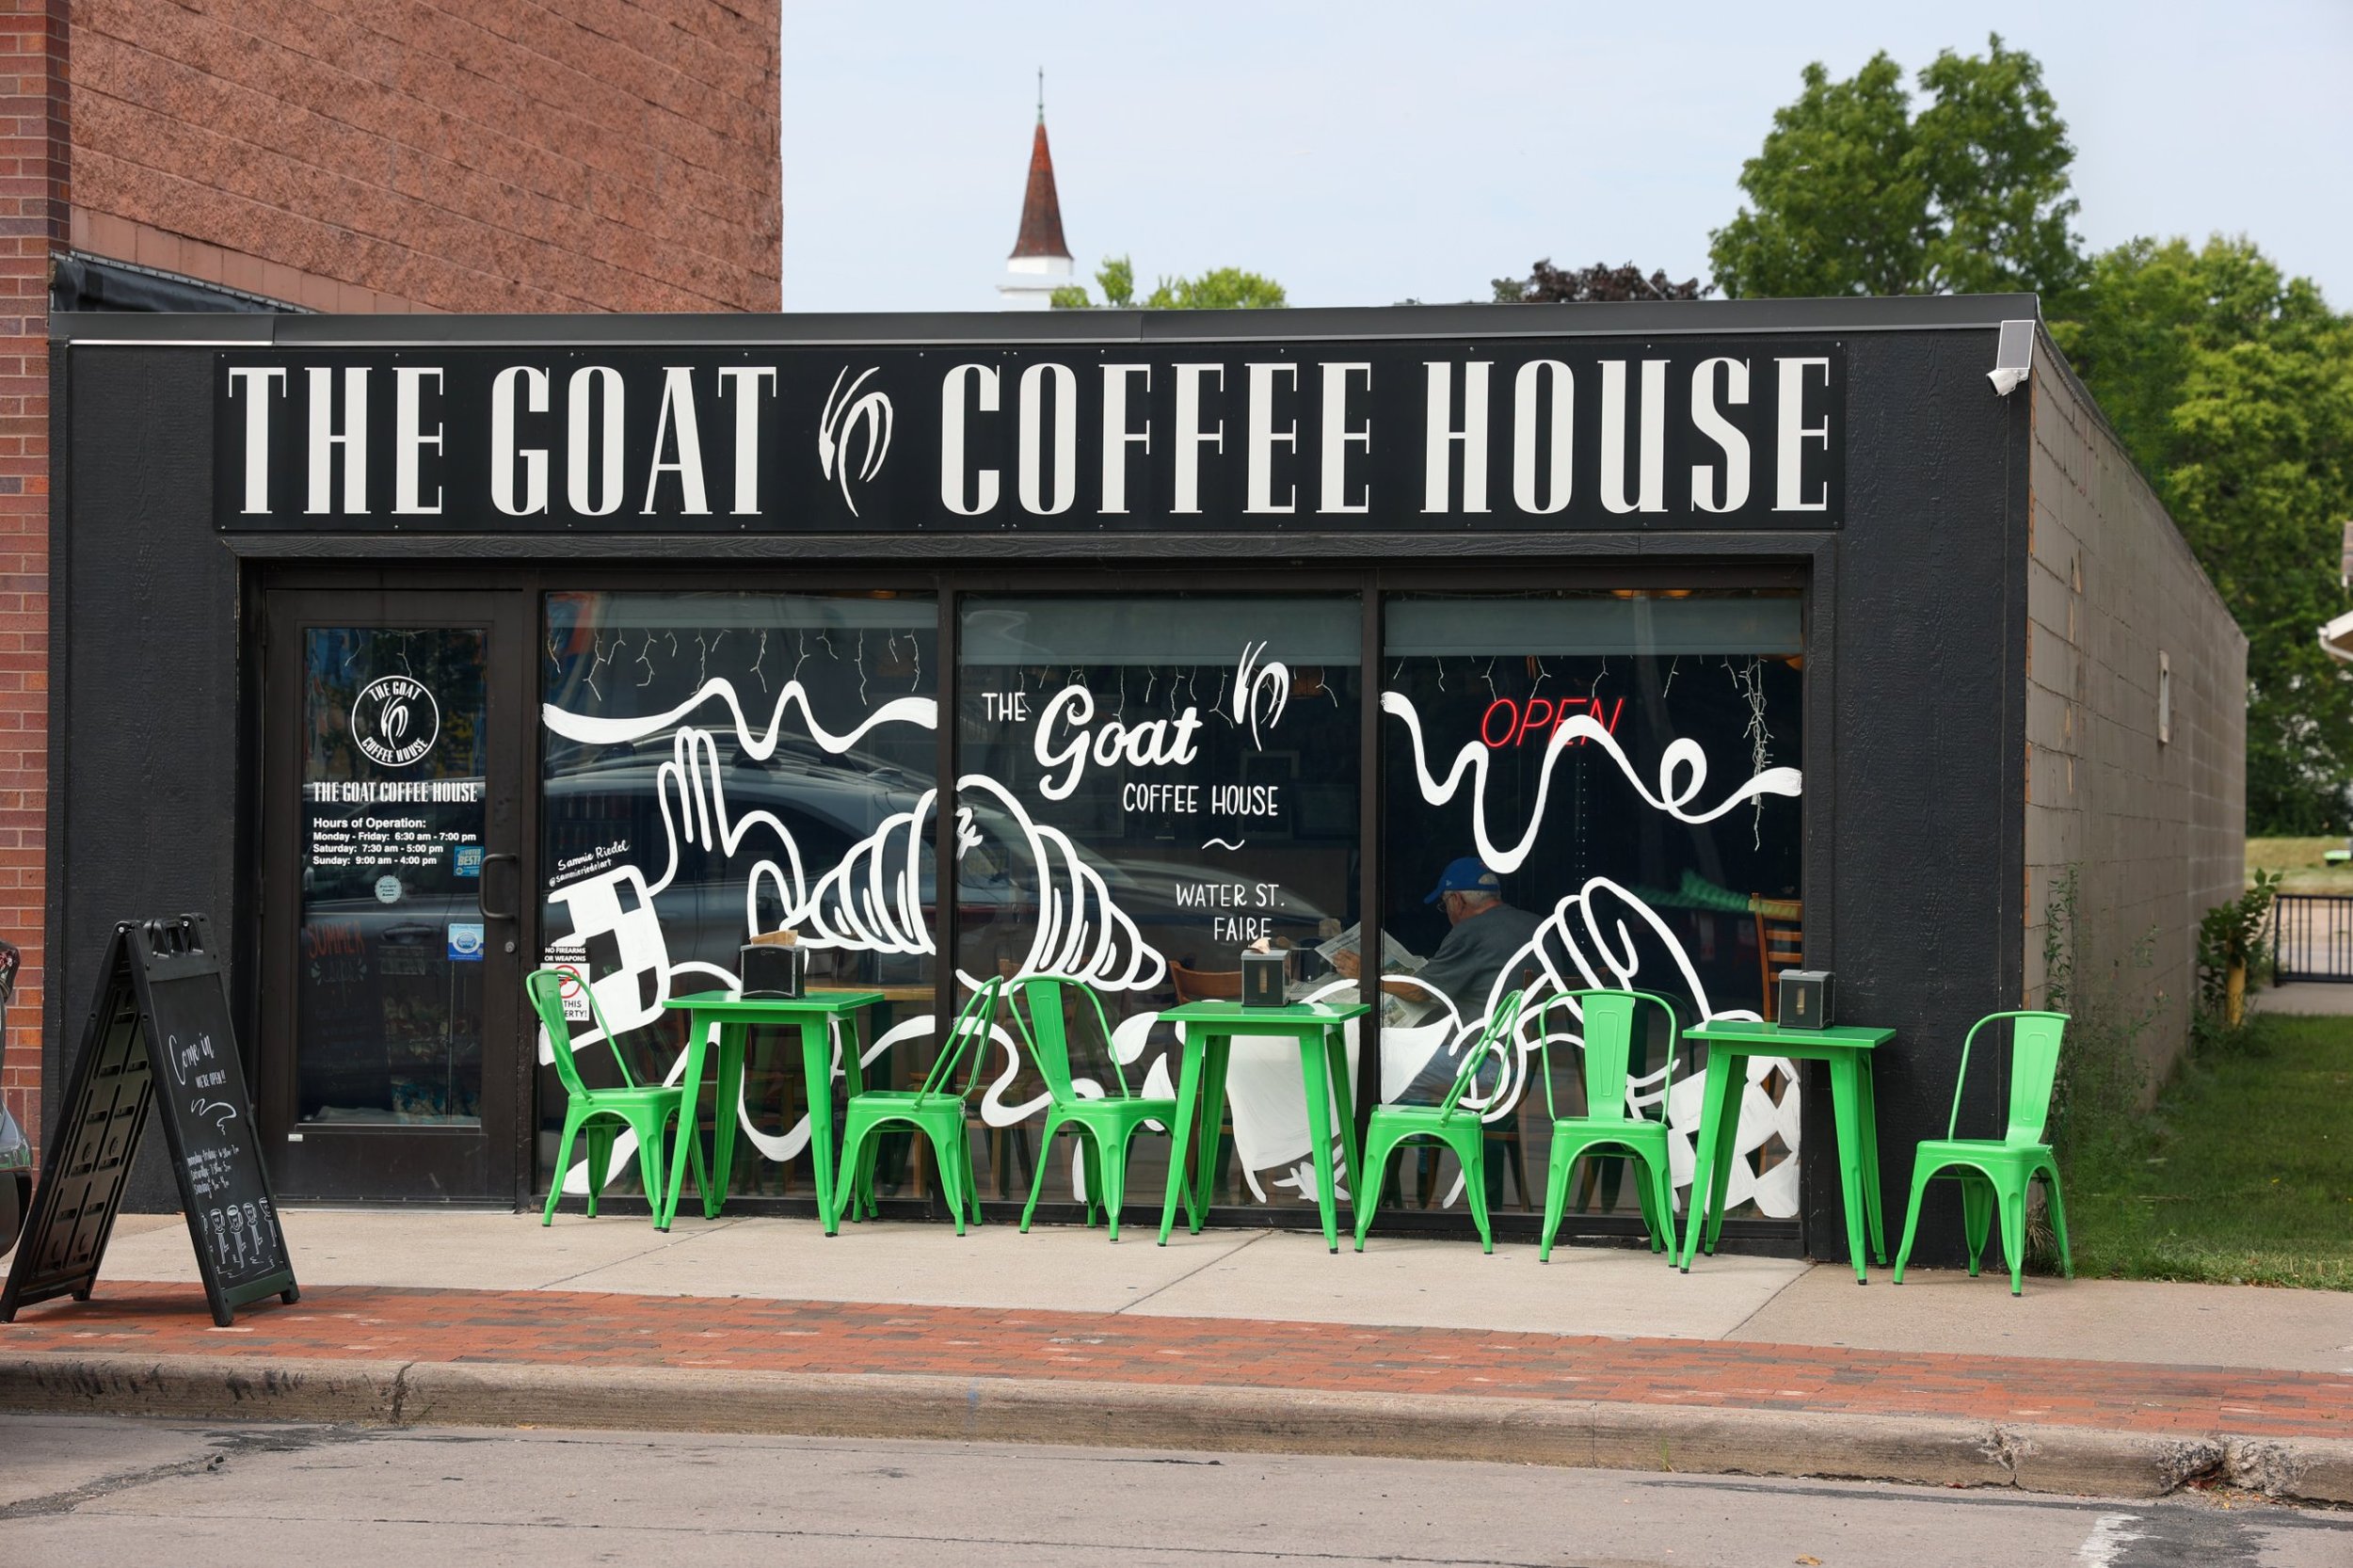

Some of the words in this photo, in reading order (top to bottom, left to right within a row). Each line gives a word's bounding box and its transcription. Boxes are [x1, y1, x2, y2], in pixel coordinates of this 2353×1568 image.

[228, 366, 444, 515] THE
[491, 365, 777, 517] GOAT
[940, 362, 1371, 516] COFFEE
[1420, 357, 1830, 515] HOUSE
[368, 682, 392, 701] THE
[392, 681, 423, 700] GOAT
[1480, 695, 1627, 750] OPEN
[361, 736, 393, 763] COFFEE
[395, 737, 429, 762] HOUSE
[982, 692, 1027, 722] THE
[1034, 684, 1203, 801] Goat
[312, 781, 340, 802] THE
[342, 781, 376, 802] GOAT
[379, 781, 430, 802] COFFEE
[432, 781, 478, 802] HOUSE
[1122, 783, 1199, 813] COFFEE
[1211, 785, 1279, 816] HOUSE
[312, 817, 348, 828] Hours
[351, 817, 363, 828] of
[365, 817, 426, 830] Operation:
[312, 832, 350, 842] Monday
[358, 832, 390, 842] Friday:
[394, 832, 415, 840] 6:30
[439, 832, 459, 840] 7:00
[461, 834, 476, 843] pm
[312, 843, 357, 855] Saturday:
[361, 844, 382, 853] 7:30
[406, 844, 426, 853] 5:00
[428, 846, 443, 855] pm
[312, 856, 350, 866] Sunday:
[355, 856, 376, 865] 9:00
[400, 856, 421, 865] 4:00
[422, 857, 437, 867] pm
[557, 852, 595, 872] Sammie
[595, 840, 631, 858] Riedel
[1176, 883, 1247, 907] WATER
[1255, 883, 1286, 907] ST.
[1214, 917, 1273, 942] FAIRE
[168, 1034, 200, 1085] Come
